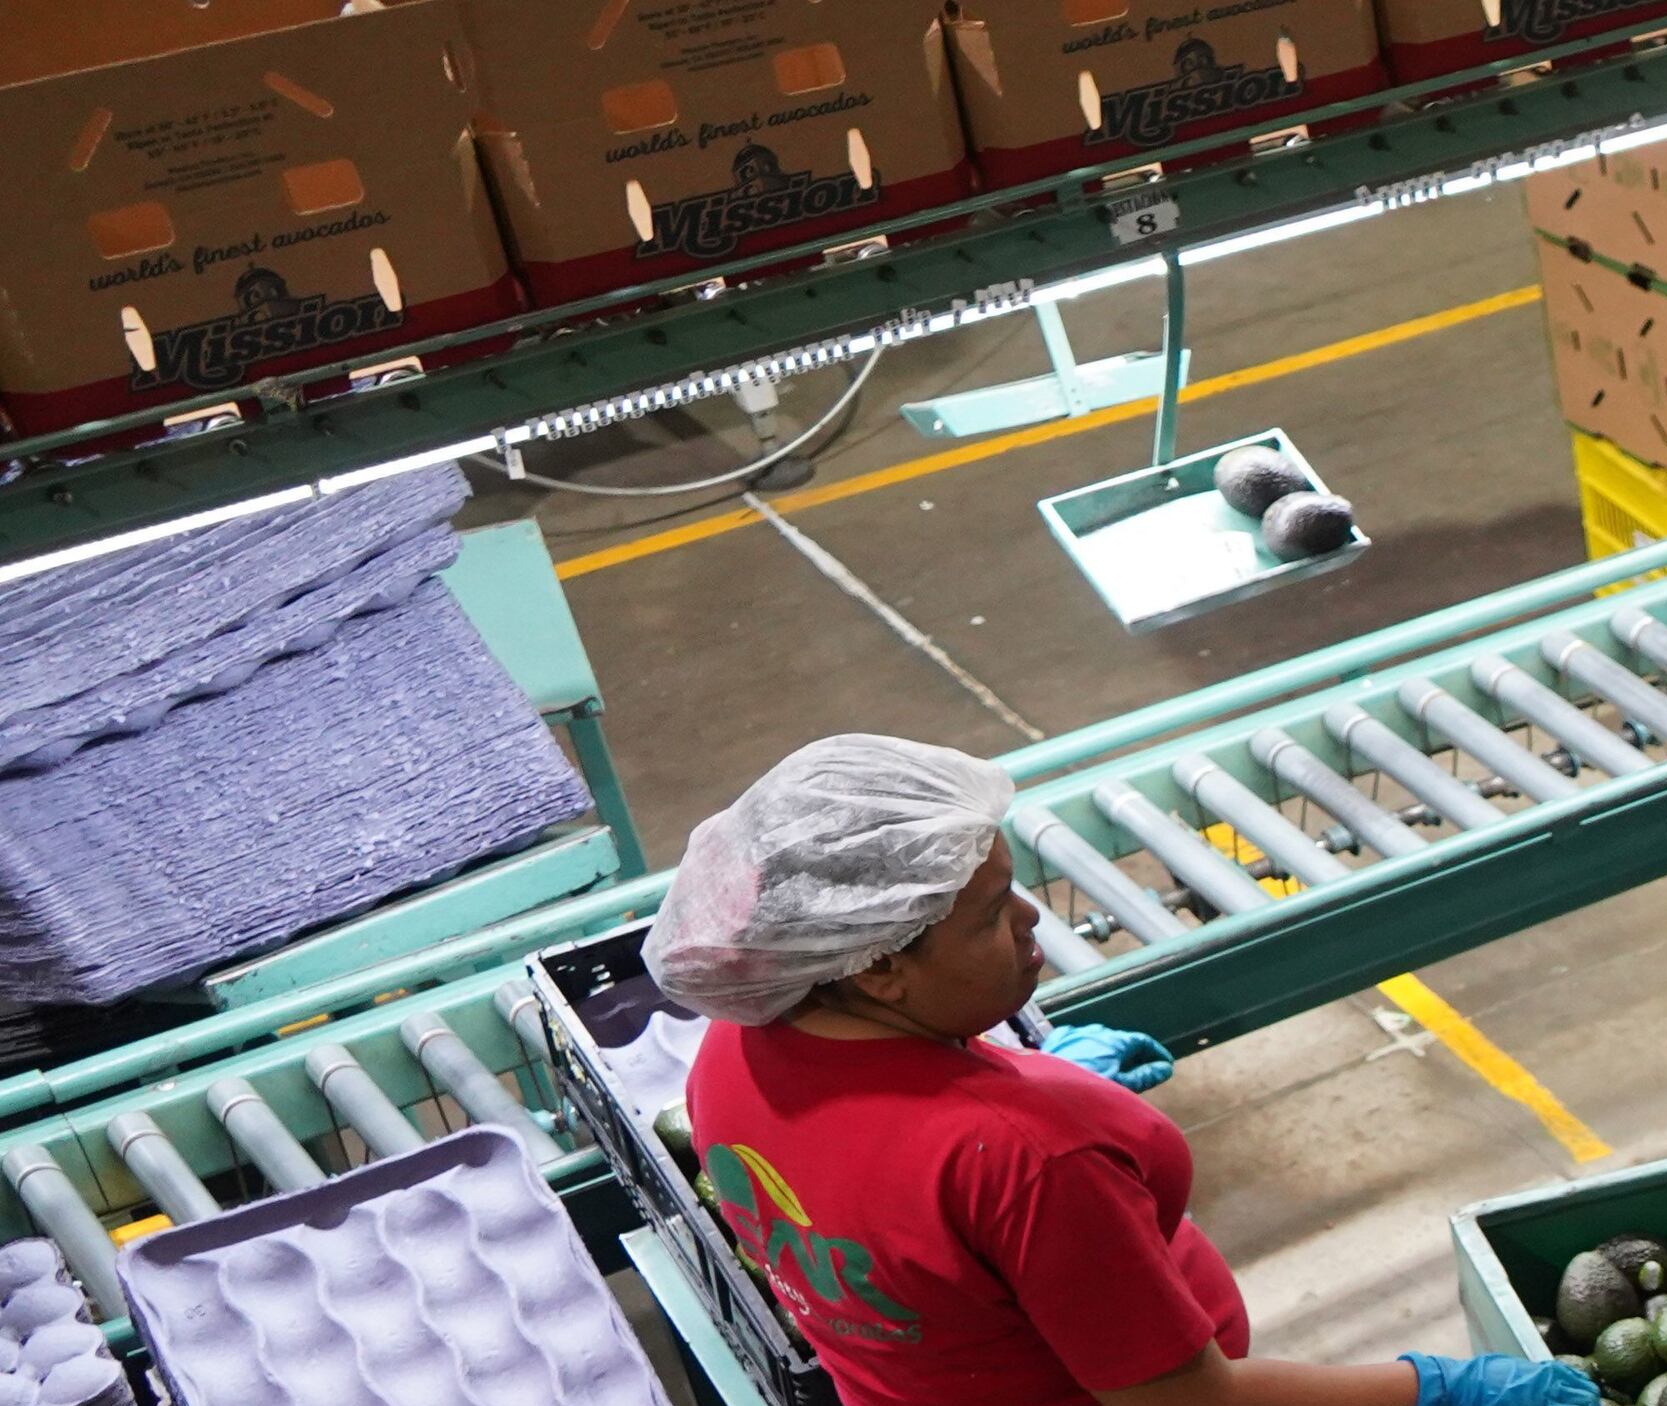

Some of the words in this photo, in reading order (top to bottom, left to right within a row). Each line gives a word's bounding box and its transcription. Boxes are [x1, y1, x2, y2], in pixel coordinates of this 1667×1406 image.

[1145, 9, 1202, 41] finest
[606, 125, 691, 164] world's
[698, 111, 761, 150] finest
[766, 90, 874, 127] avocados
[1084, 62, 1304, 146] Mission
[90, 251, 184, 291] world's
[193, 231, 267, 275] finest
[270, 210, 392, 249] avocados
[637, 167, 880, 258] Mission
[1136, 213, 1158, 235] 8
[130, 293, 405, 392] Mission
